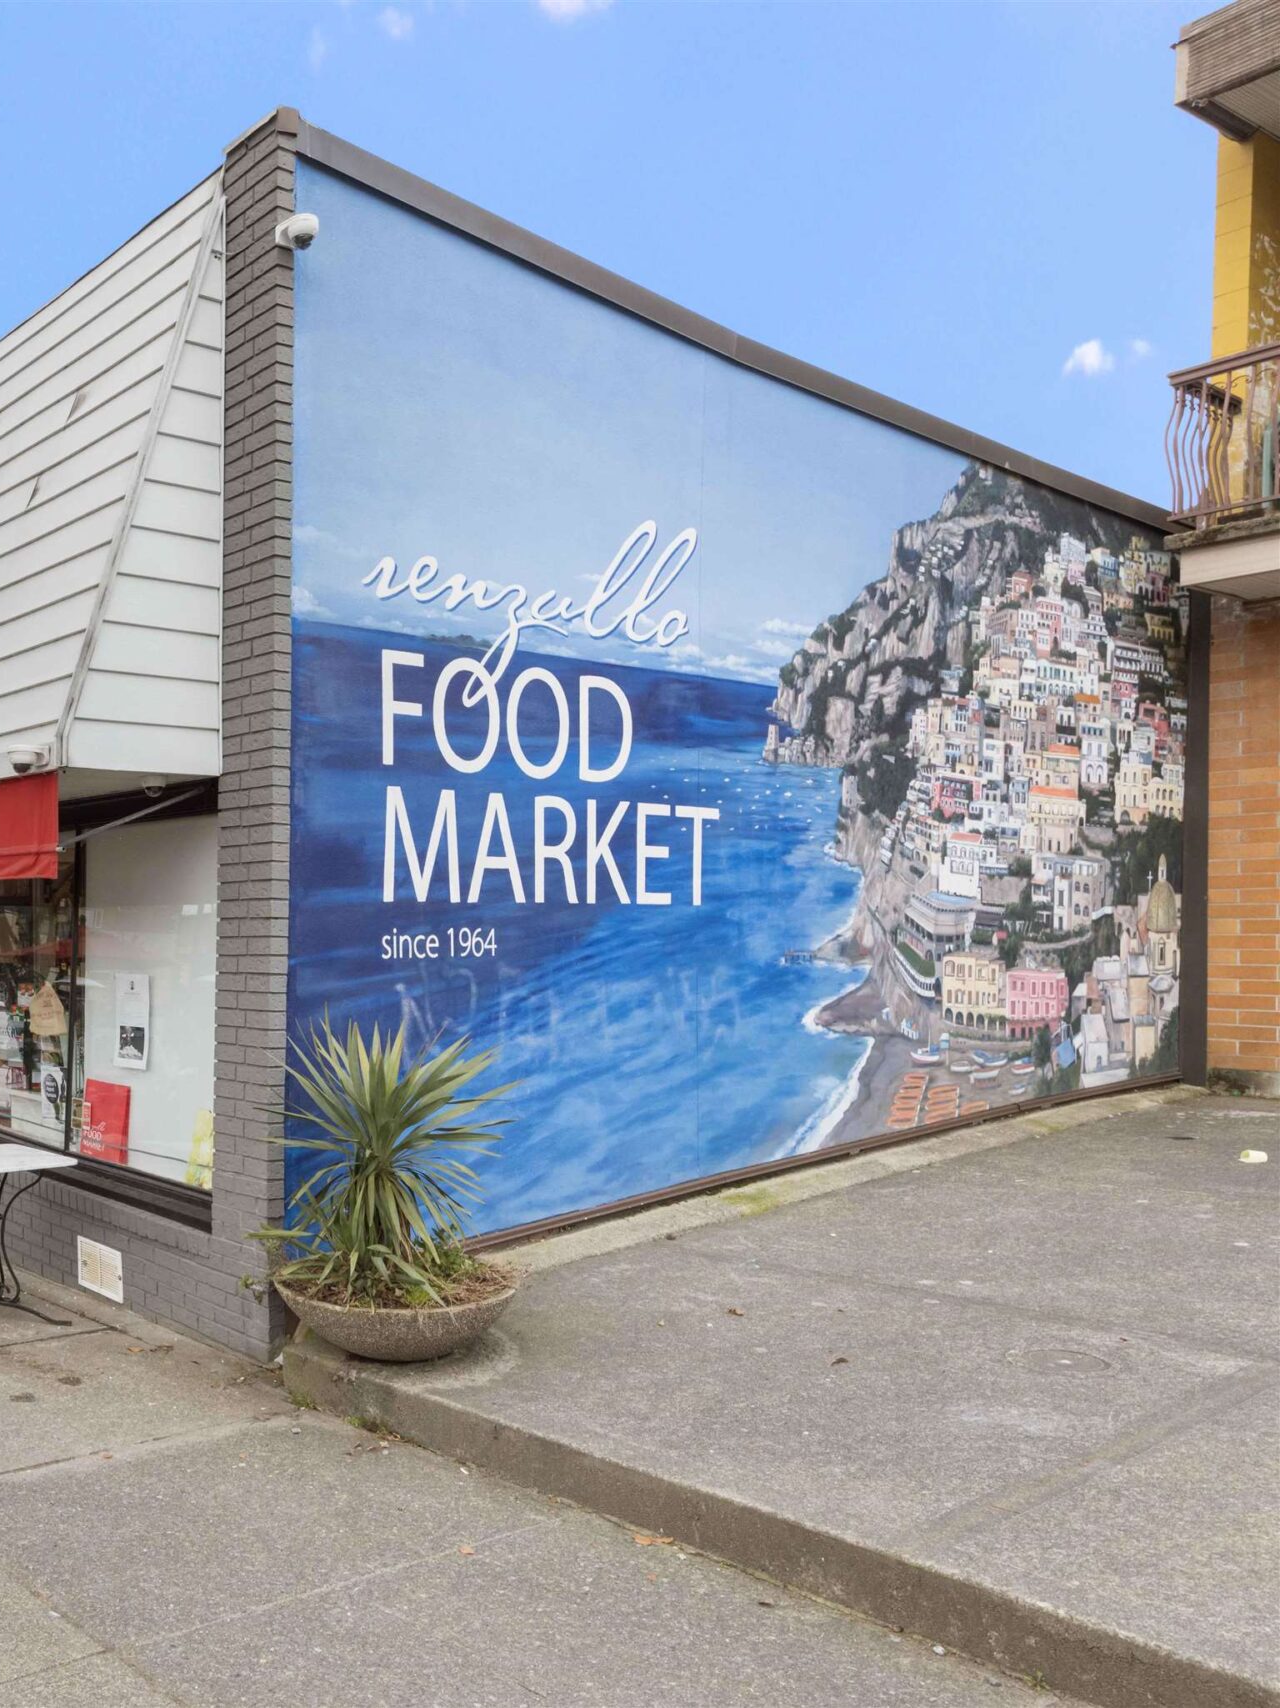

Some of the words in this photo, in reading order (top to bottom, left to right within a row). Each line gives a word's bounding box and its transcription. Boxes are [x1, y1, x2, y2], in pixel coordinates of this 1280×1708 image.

[361, 519, 698, 708] renzullo
[381, 649, 633, 783] FOOD
[382, 785, 720, 906] MARKET
[381, 927, 440, 960] since
[447, 927, 498, 958] 1964
